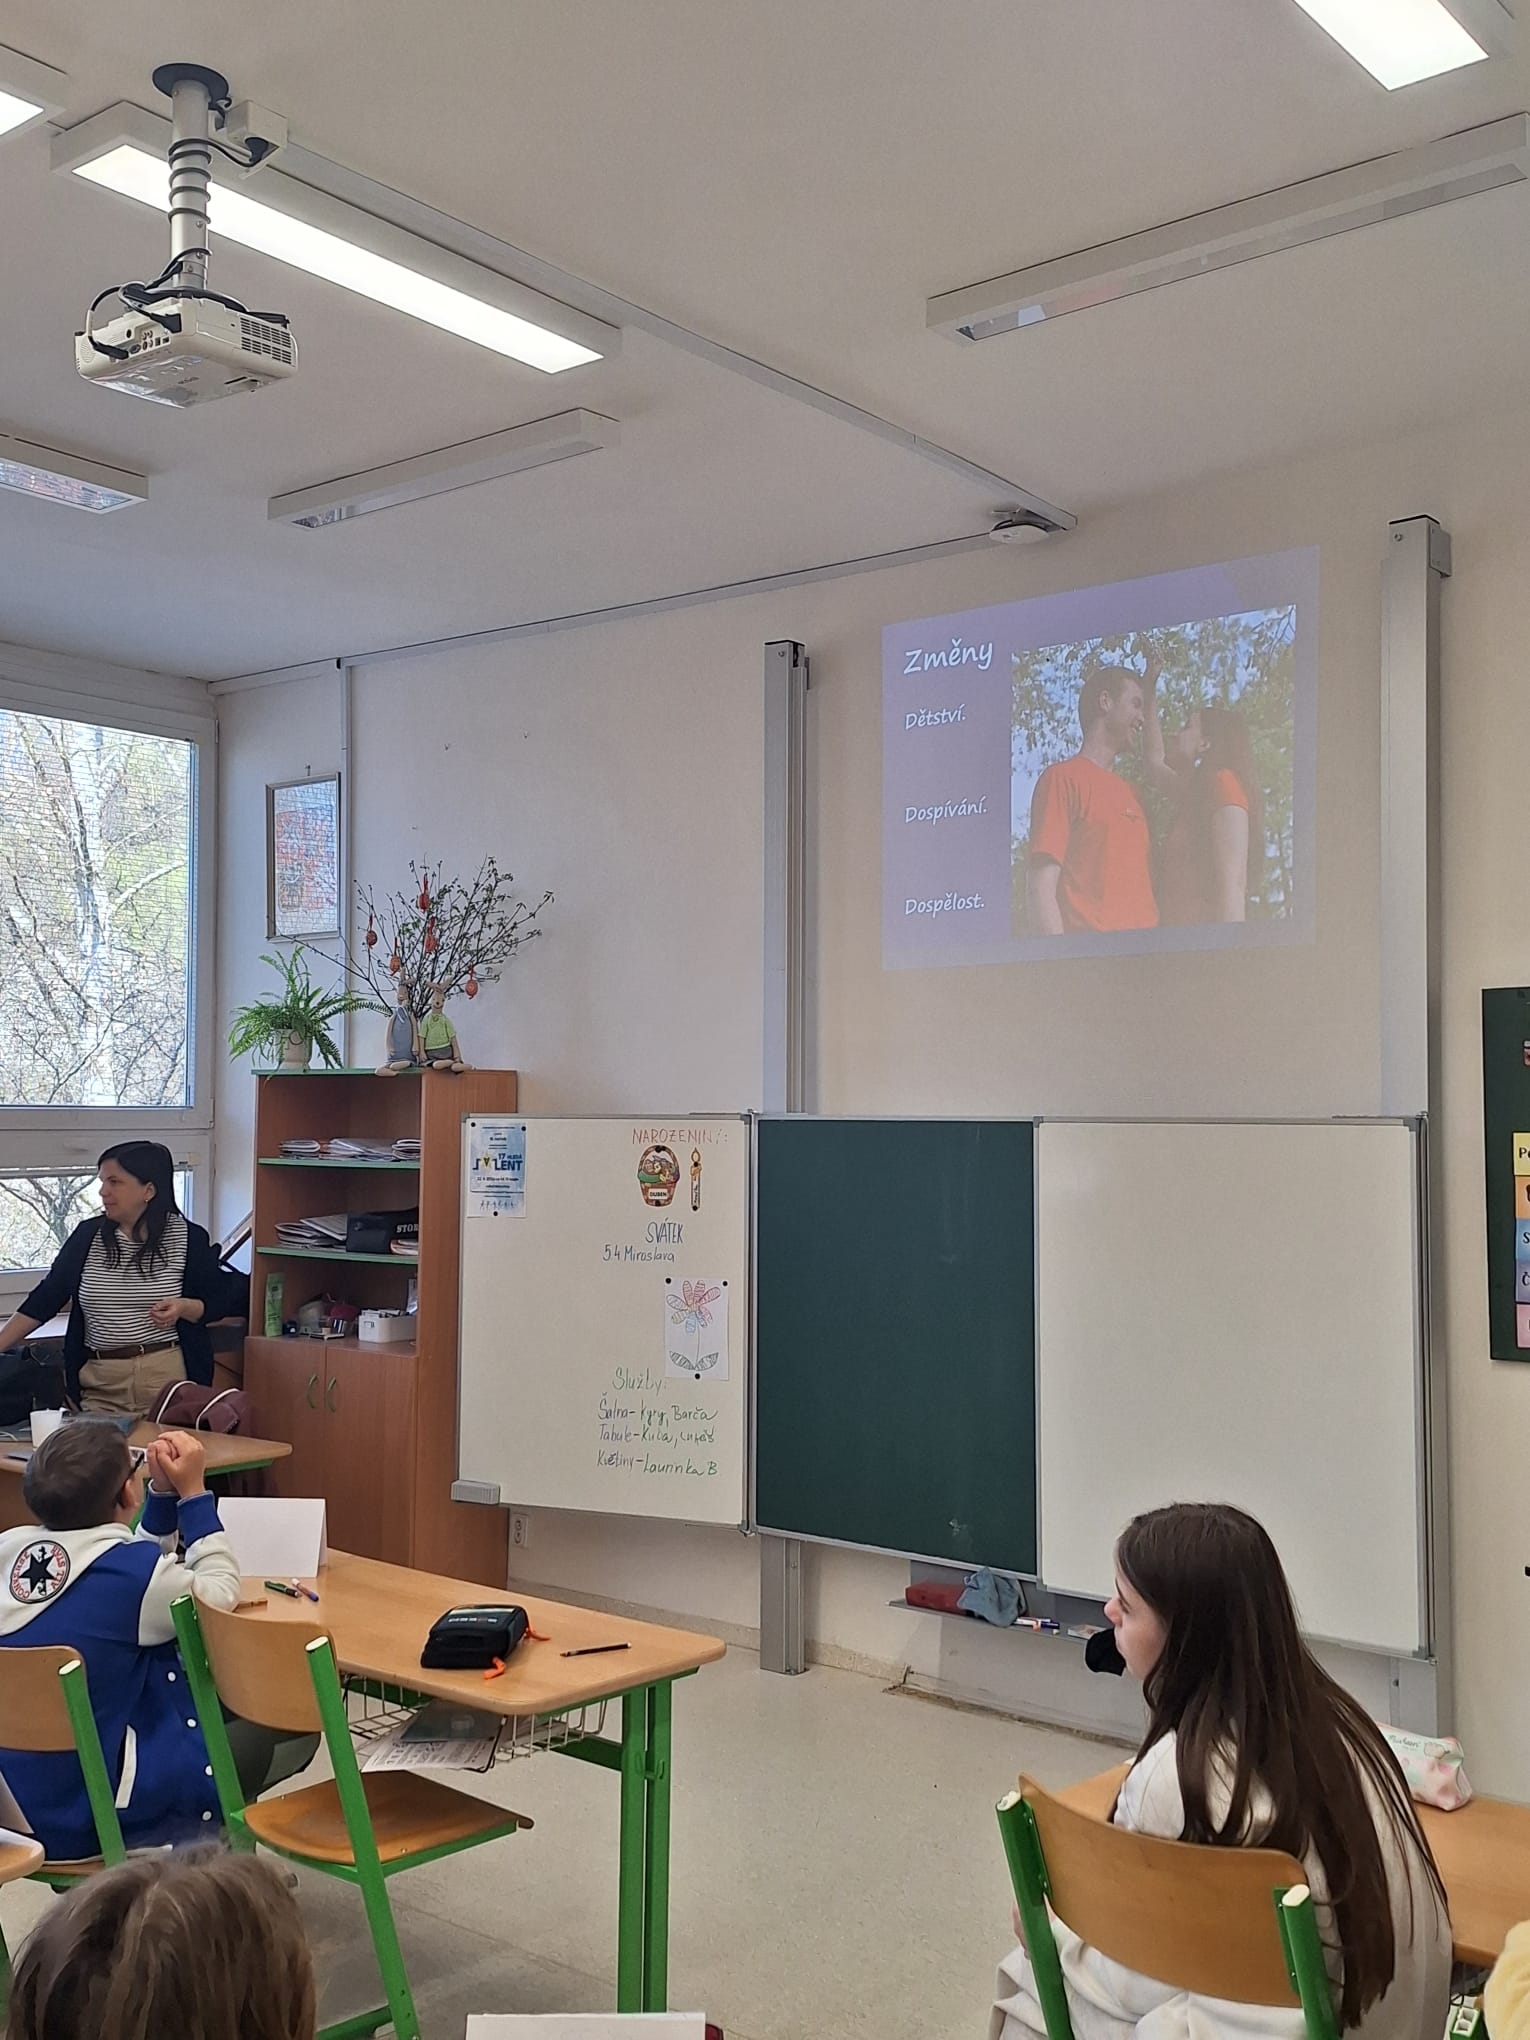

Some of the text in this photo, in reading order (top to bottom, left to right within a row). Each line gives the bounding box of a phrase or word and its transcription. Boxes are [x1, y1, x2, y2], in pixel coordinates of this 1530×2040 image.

[903, 638, 993, 675] Změny
[905, 796, 987, 825] Dospívání.
[905, 892, 985, 918] Dospělost.
[645, 1218, 684, 1243] SVÁTEK
[624, 1245, 675, 1263] Miroslava
